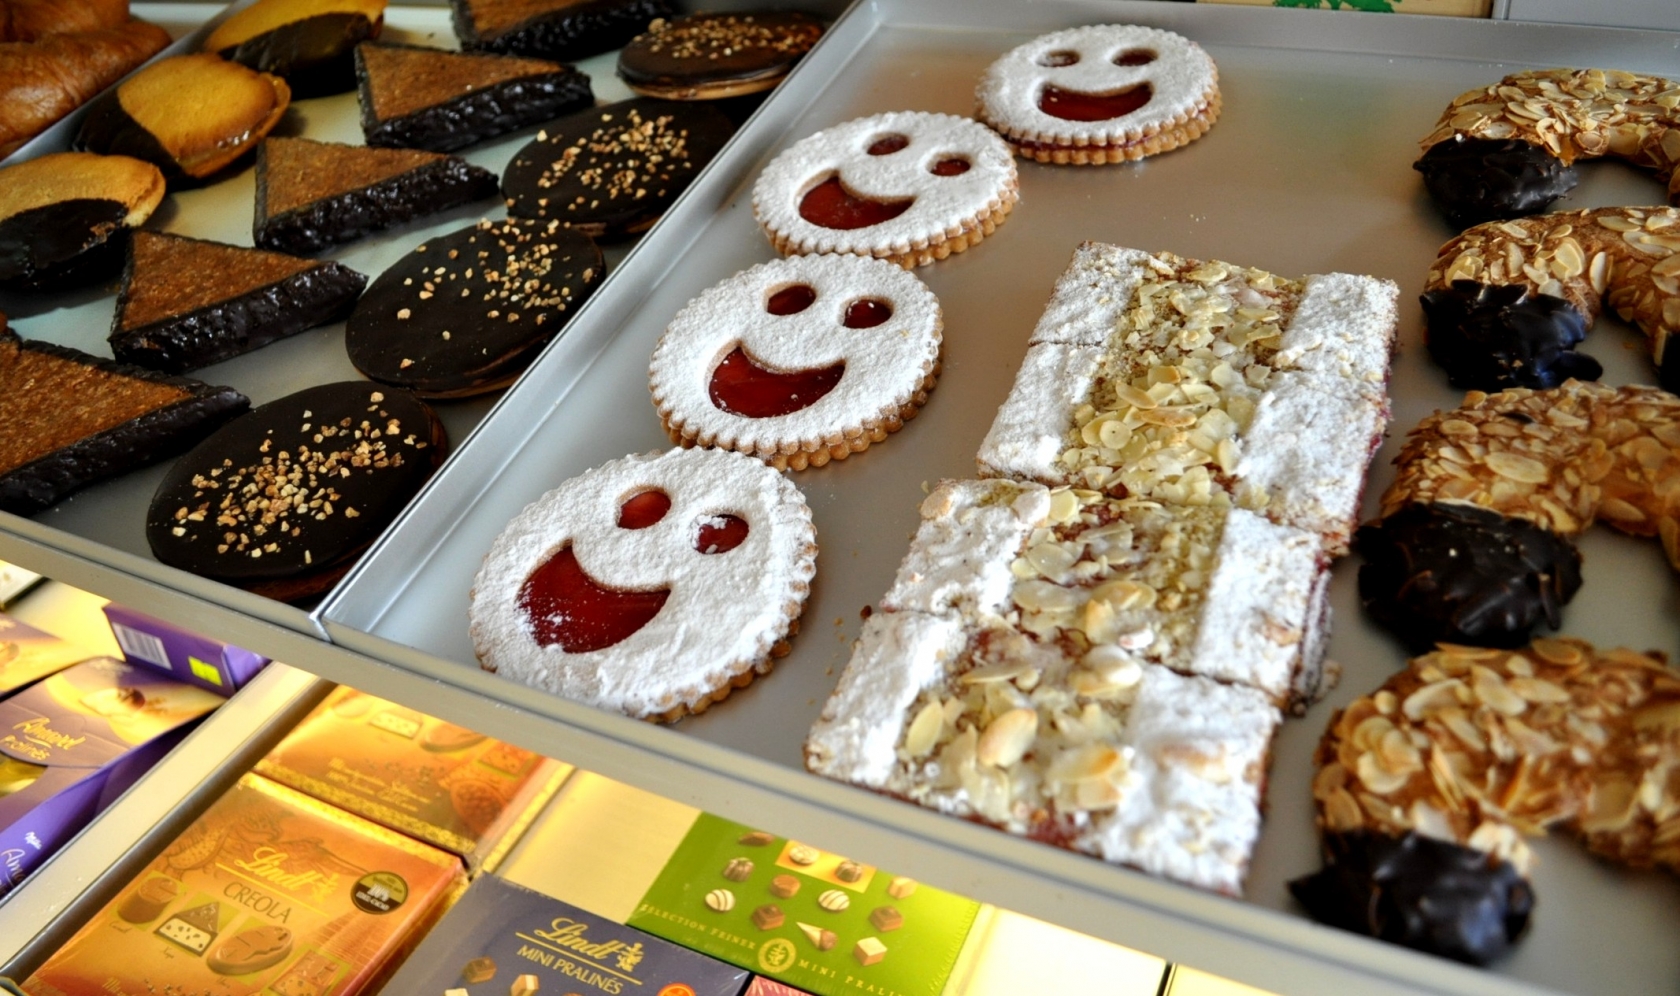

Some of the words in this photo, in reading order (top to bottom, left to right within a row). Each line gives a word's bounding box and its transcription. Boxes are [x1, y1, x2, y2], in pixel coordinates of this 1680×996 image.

[234, 846, 323, 891] Lindt
[223, 881, 292, 924] CREOLA
[534, 917, 627, 959] Lindt
[517, 945, 555, 967] MINI
[552, 958, 624, 995] PRALINÉS
[798, 959, 836, 978] MINI
